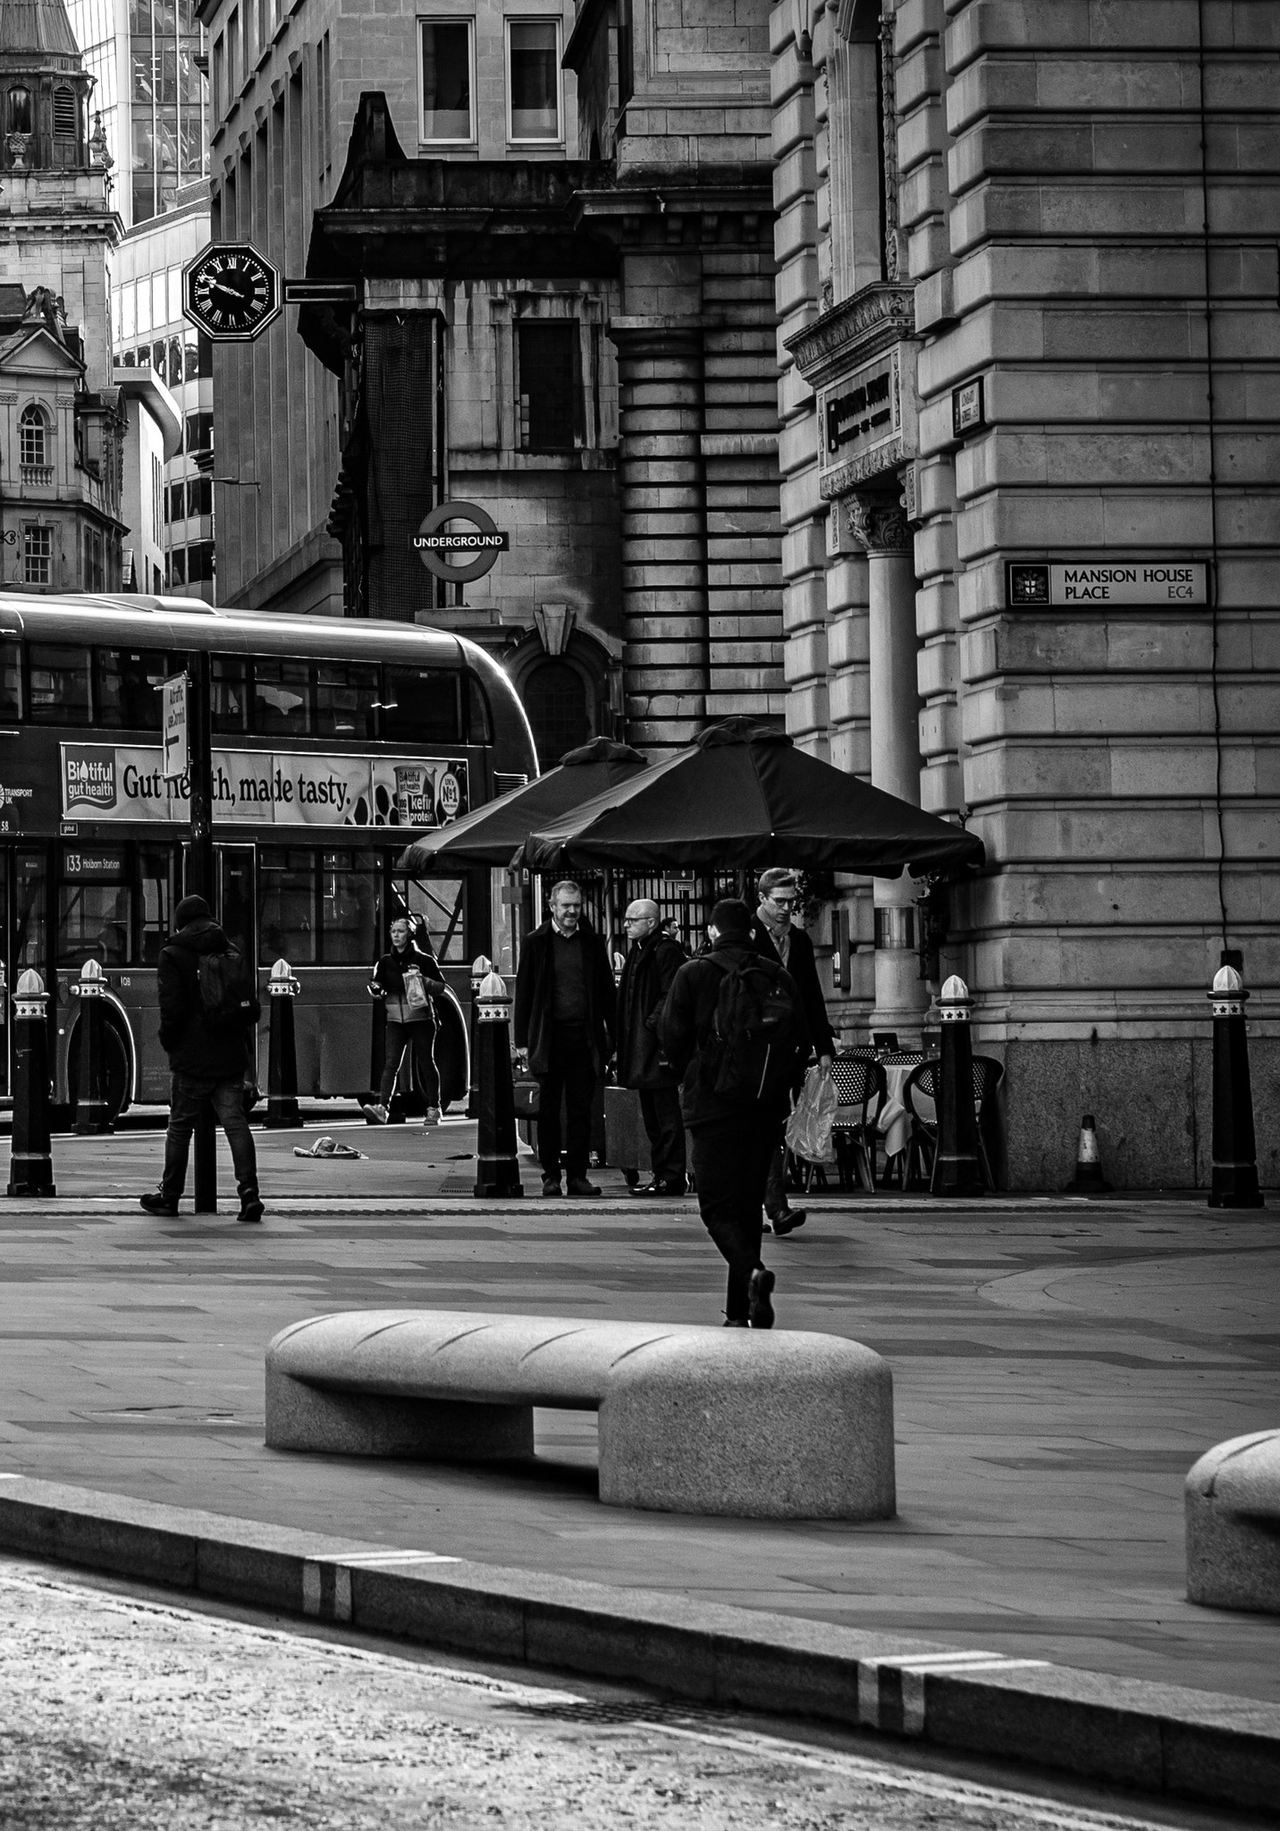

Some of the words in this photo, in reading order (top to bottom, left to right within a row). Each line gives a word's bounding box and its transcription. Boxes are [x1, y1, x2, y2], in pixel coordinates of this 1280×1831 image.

[413, 536, 503, 547] UNDERGROUND
[1064, 569, 1137, 583] MANSION
[1143, 569, 1193, 583] HOUSE
[1065, 586, 1110, 599] PLACE
[1167, 586, 1194, 599] EC4
[4, 788, 33, 797] TRANSPORT
[68, 783, 84, 799] gut
[85, 782, 114, 797] health
[123, 765, 162, 799] Gut
[239, 769, 293, 803] made
[297, 773, 351, 812] tasty.
[411, 793, 432, 810] kefir
[410, 811, 433, 824] protein
[66, 855, 81, 872] 133
[82, 858, 102, 869] Holborn
[103, 858, 120, 869] Station
